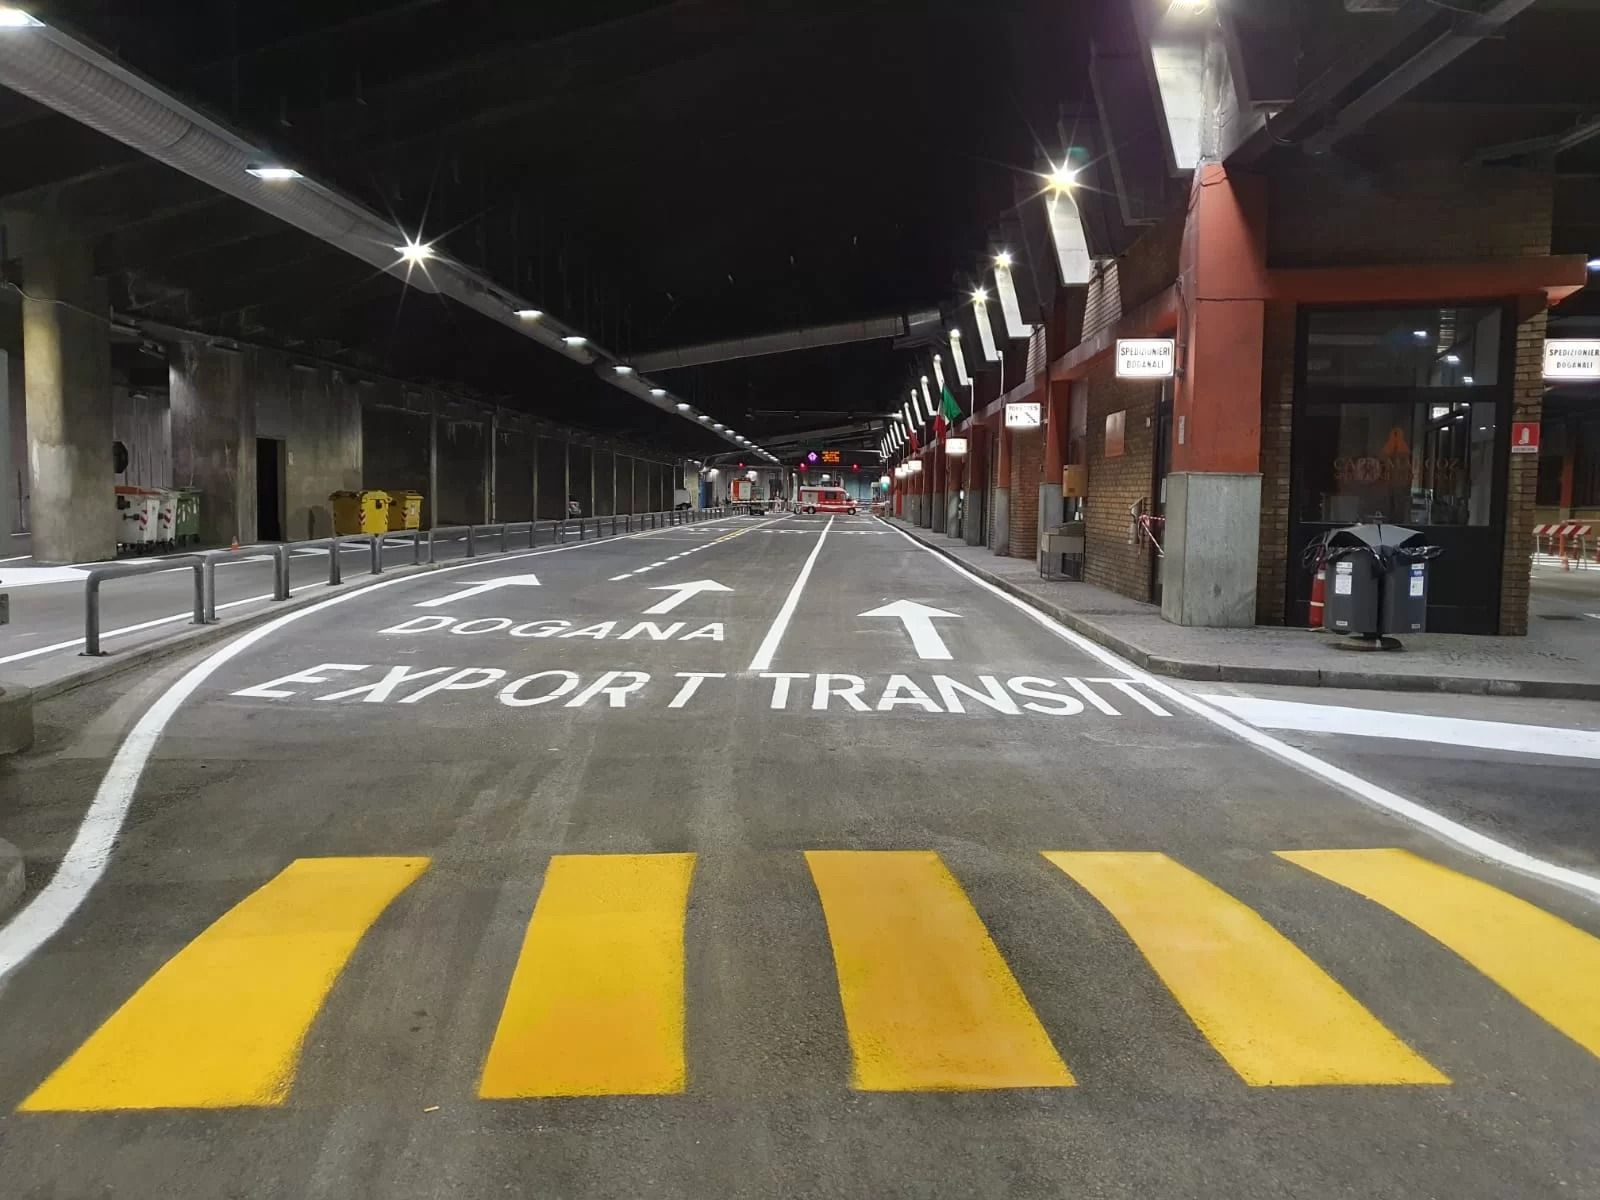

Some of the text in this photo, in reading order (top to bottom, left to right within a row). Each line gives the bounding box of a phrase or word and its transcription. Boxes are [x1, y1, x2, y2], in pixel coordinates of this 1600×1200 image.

[1126, 359, 1164, 369] DOGANALI
[379, 615, 725, 642] DOGANA
[232, 663, 1174, 717] EXPORT TRANSIT
